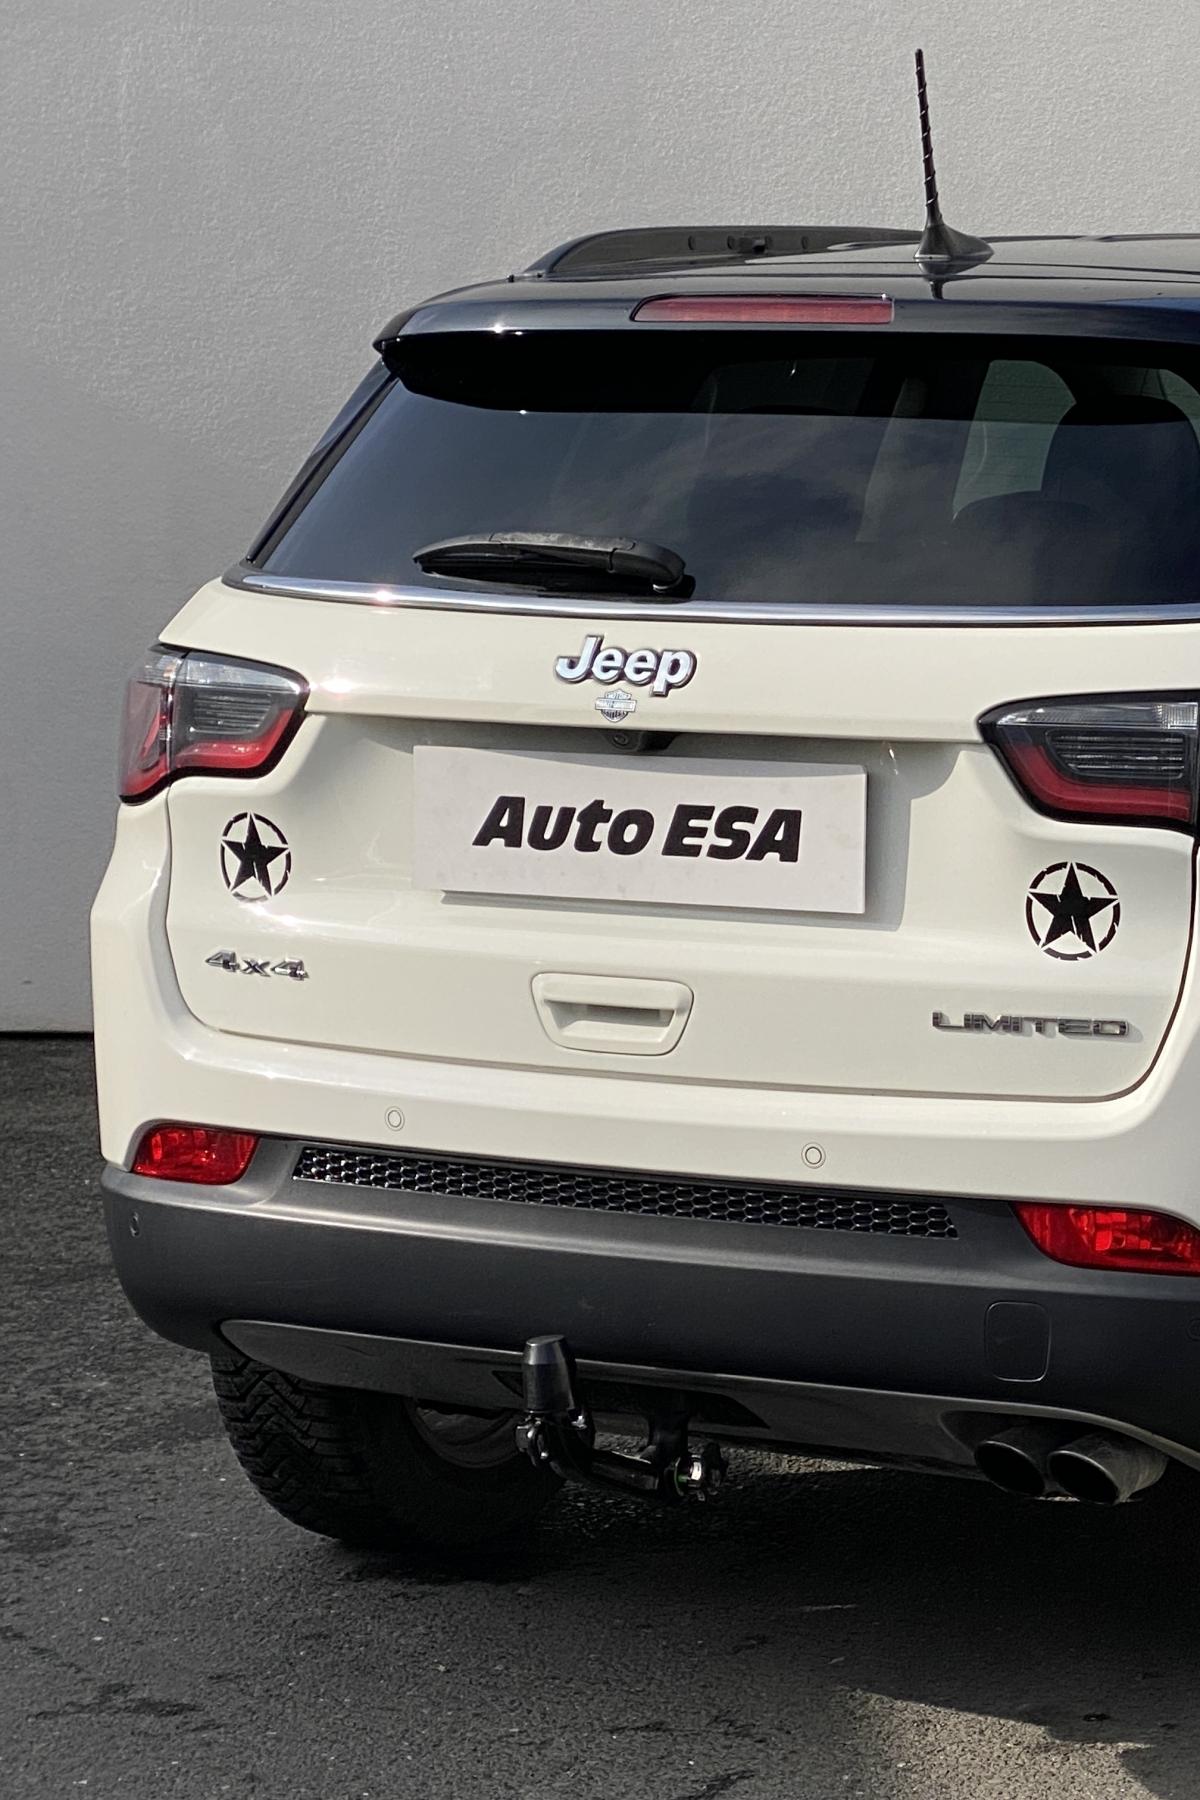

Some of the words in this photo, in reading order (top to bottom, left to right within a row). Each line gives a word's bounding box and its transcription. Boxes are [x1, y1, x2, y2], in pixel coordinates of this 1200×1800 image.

[555, 634, 697, 697] Jeep
[472, 795, 655, 856] Auto
[661, 803, 803, 863] ESA
[932, 1011, 1129, 1037] LIMITED
